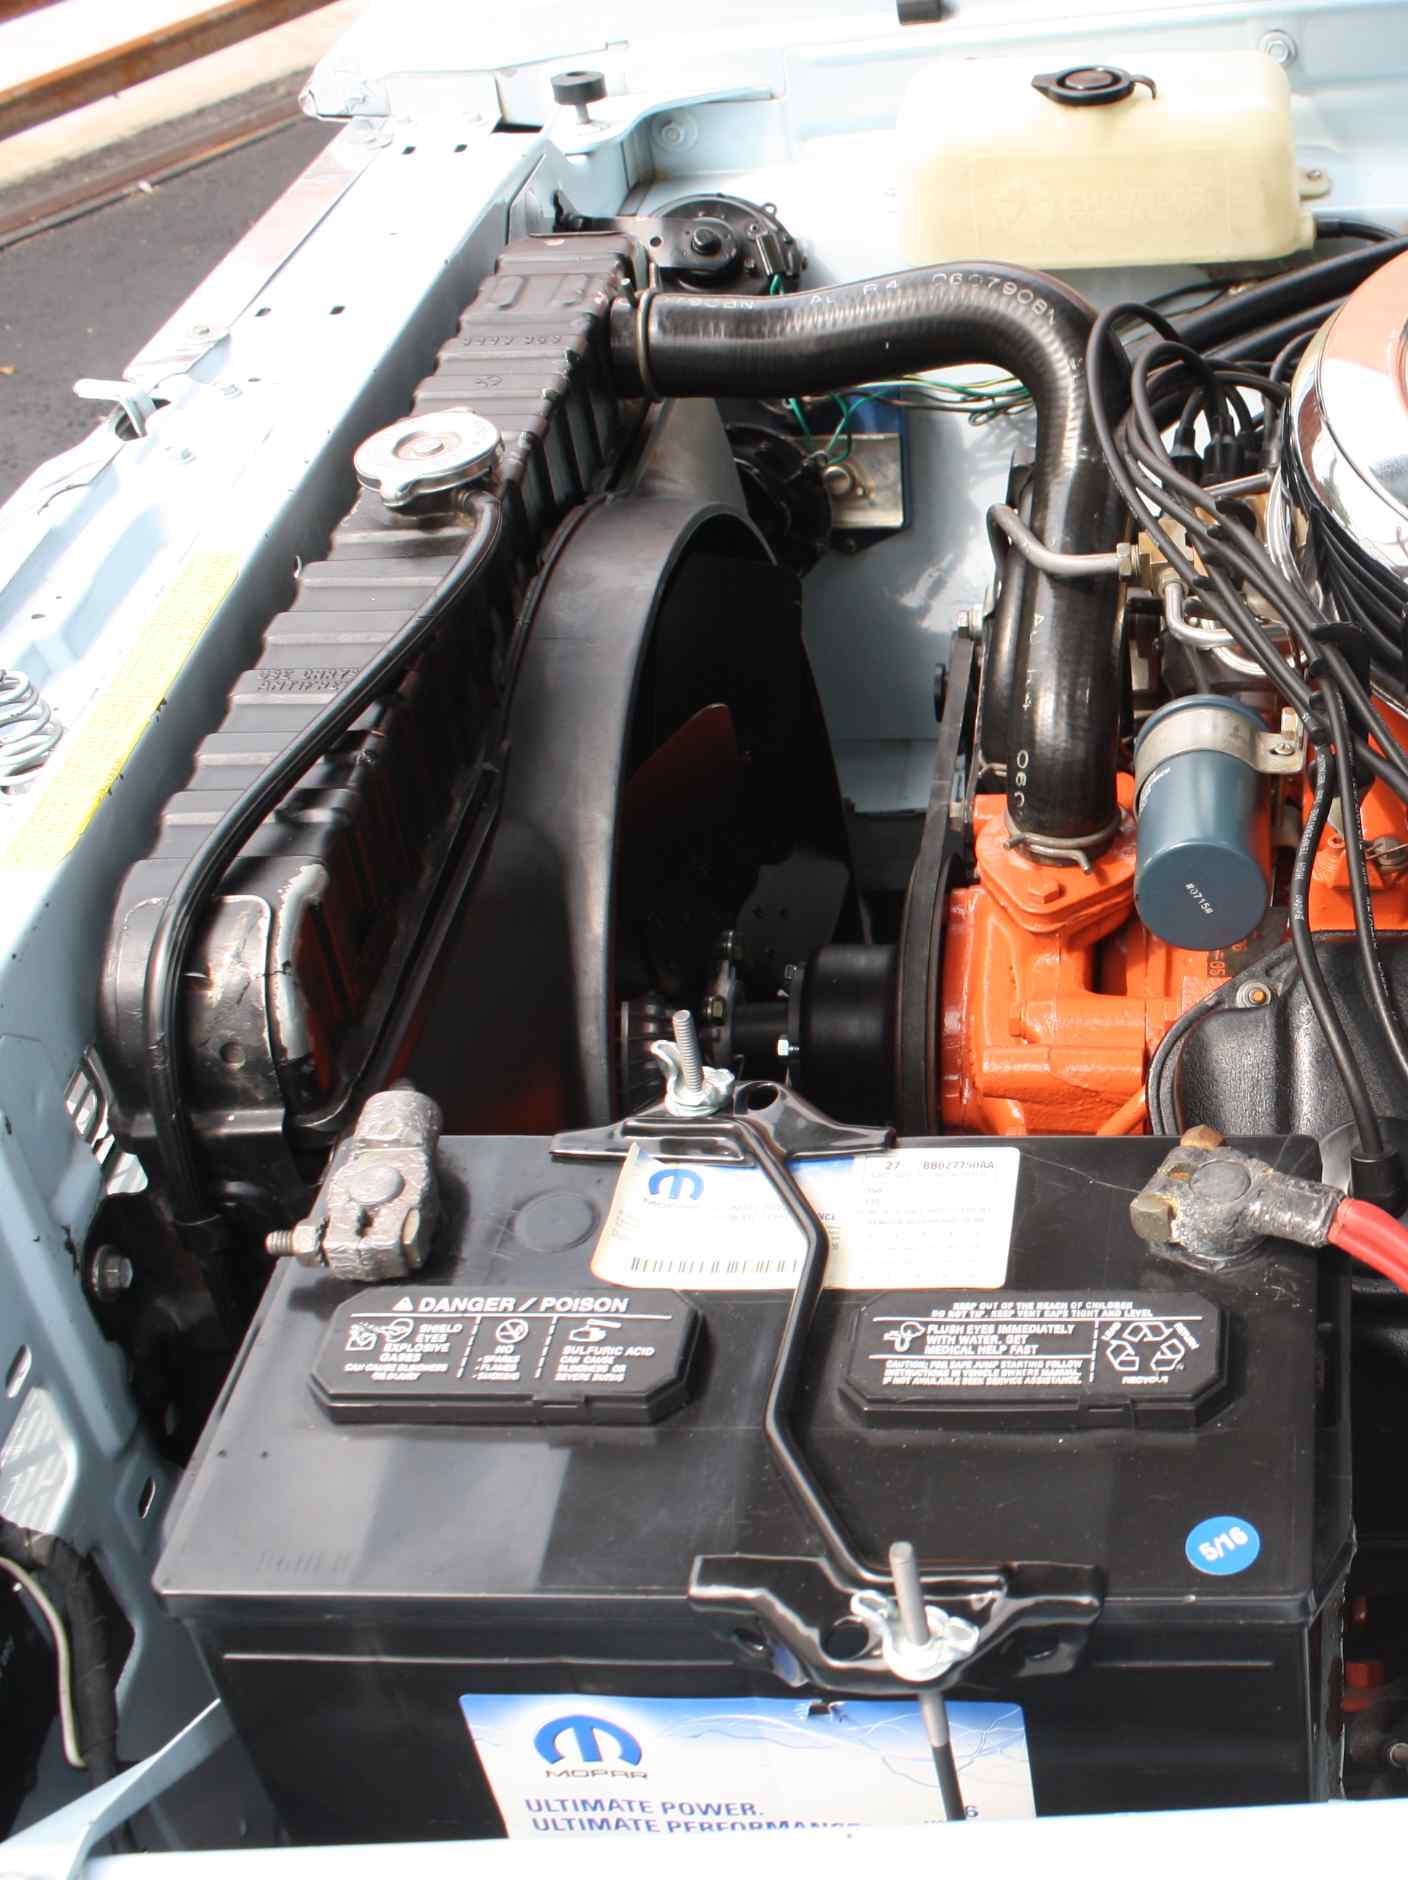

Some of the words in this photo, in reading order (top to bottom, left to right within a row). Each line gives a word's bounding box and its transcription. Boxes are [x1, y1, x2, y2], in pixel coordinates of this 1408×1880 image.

[885, 1160, 901, 1170] 27
[418, 1296, 517, 1313] DANGER
[540, 1296, 629, 1313] POISON
[953, 1301, 977, 1310] KEEP
[978, 1301, 999, 1310] OUT
[1000, 1301, 1015, 1310] OF
[1016, 1301, 1035, 1310] THE
[1036, 1301, 1068, 1310] REACH
[1070, 1301, 1084, 1310] OF
[1085, 1301, 1133, 1310] CHILDREN
[931, 1309, 946, 1318] DO
[947, 1309, 969, 1318] NOT
[990, 1309, 1015, 1318] KEEP
[1017, 1309, 1043, 1318] VENT
[1044, 1309, 1069, 1318] CAPS
[1071, 1309, 1099, 1318] TIGHT
[1100, 1309, 1123, 1318] AND
[419, 1323, 464, 1333] SHIELD
[927, 1324, 965, 1335] FLUSH
[966, 1324, 996, 1335] EYES
[997, 1324, 1076, 1334] IMMEDIATELY
[415, 1333, 448, 1343] EYES
[926, 1334, 957, 1345] WITH
[1005, 1334, 1029, 1345] GET
[383, 1342, 450, 1353] EXPLOSIVE
[495, 1345, 515, 1354] NO
[561, 1345, 623, 1356] SULFURIC
[624, 1346, 655, 1356] ACID
[924, 1345, 975, 1355] MEDICAL
[976, 1345, 1008, 1355] HELP
[1009, 1345, 1040, 1355] FAST
[379, 1352, 423, 1362] GASES
[559, 1356, 578, 1364] CAN
[583, 1356, 615, 1365] CAUSE
[557, 1364, 609, 1373] BLINDNESS
[611, 1364, 627, 1373] OR
[929, 1360, 949, 1369] FOR
[949, 1360, 973, 1369] SAFE
[973, 1360, 1001, 1369] JUMP
[1001, 1360, 1044, 1369] STARTING
[1045, 1360, 1083, 1369] FOLLOW
[555, 1372, 591, 1381] SEVERE
[884, 1368, 950, 1377] INSTRUCTIONS
[962, 1368, 1000, 1377] VEHICLE
[892, 1377, 912, 1385] NOT
[911, 1377, 961, 1385] AVAILABLE
[961, 1377, 985, 1385] SEEK
[985, 1376, 1028, 1385] SERVICE
[1198, 1525, 1249, 1562] 5/16
[545, 1768, 649, 1779] MOPAR
[525, 1798, 657, 1815] ULTIMATE
[660, 1800, 765, 1816] POWER.
[531, 1817, 661, 1833] ULTIMATE
